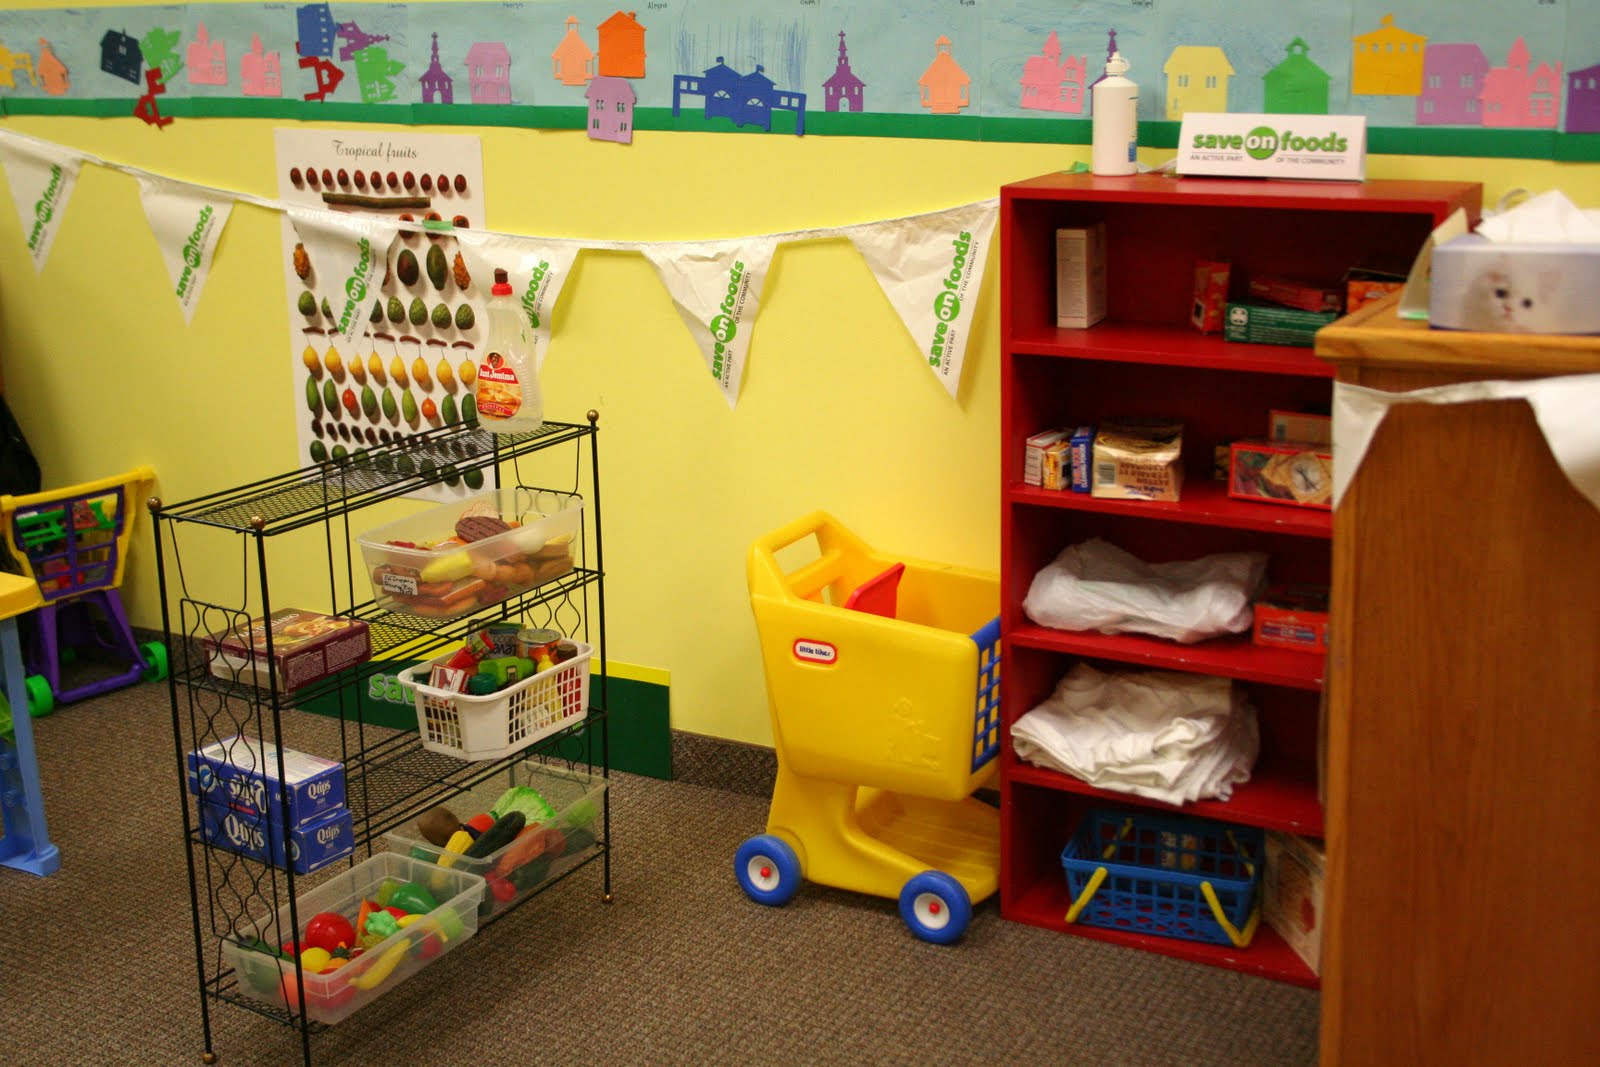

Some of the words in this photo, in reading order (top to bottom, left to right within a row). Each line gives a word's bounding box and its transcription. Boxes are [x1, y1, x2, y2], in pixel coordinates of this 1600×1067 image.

[331, 139, 384, 161] Tropical
[386, 141, 418, 163] fruits
[1192, 133, 1244, 150] save
[1280, 130, 1348, 153] foods
[188, 204, 214, 247] foods
[338, 299, 356, 335] save
[353, 237, 370, 279] foods
[520, 259, 550, 308] foods
[740, 271, 752, 304] COMMUNITY
[961, 281, 969, 292] THE
[965, 241, 980, 280] COMMUNITY
[712, 341, 725, 380] save
[720, 260, 745, 315] foods
[929, 321, 949, 368] save
[943, 230, 972, 291] foods
[945, 346, 954, 367] ACTIVE
[949, 329, 957, 347] PART
